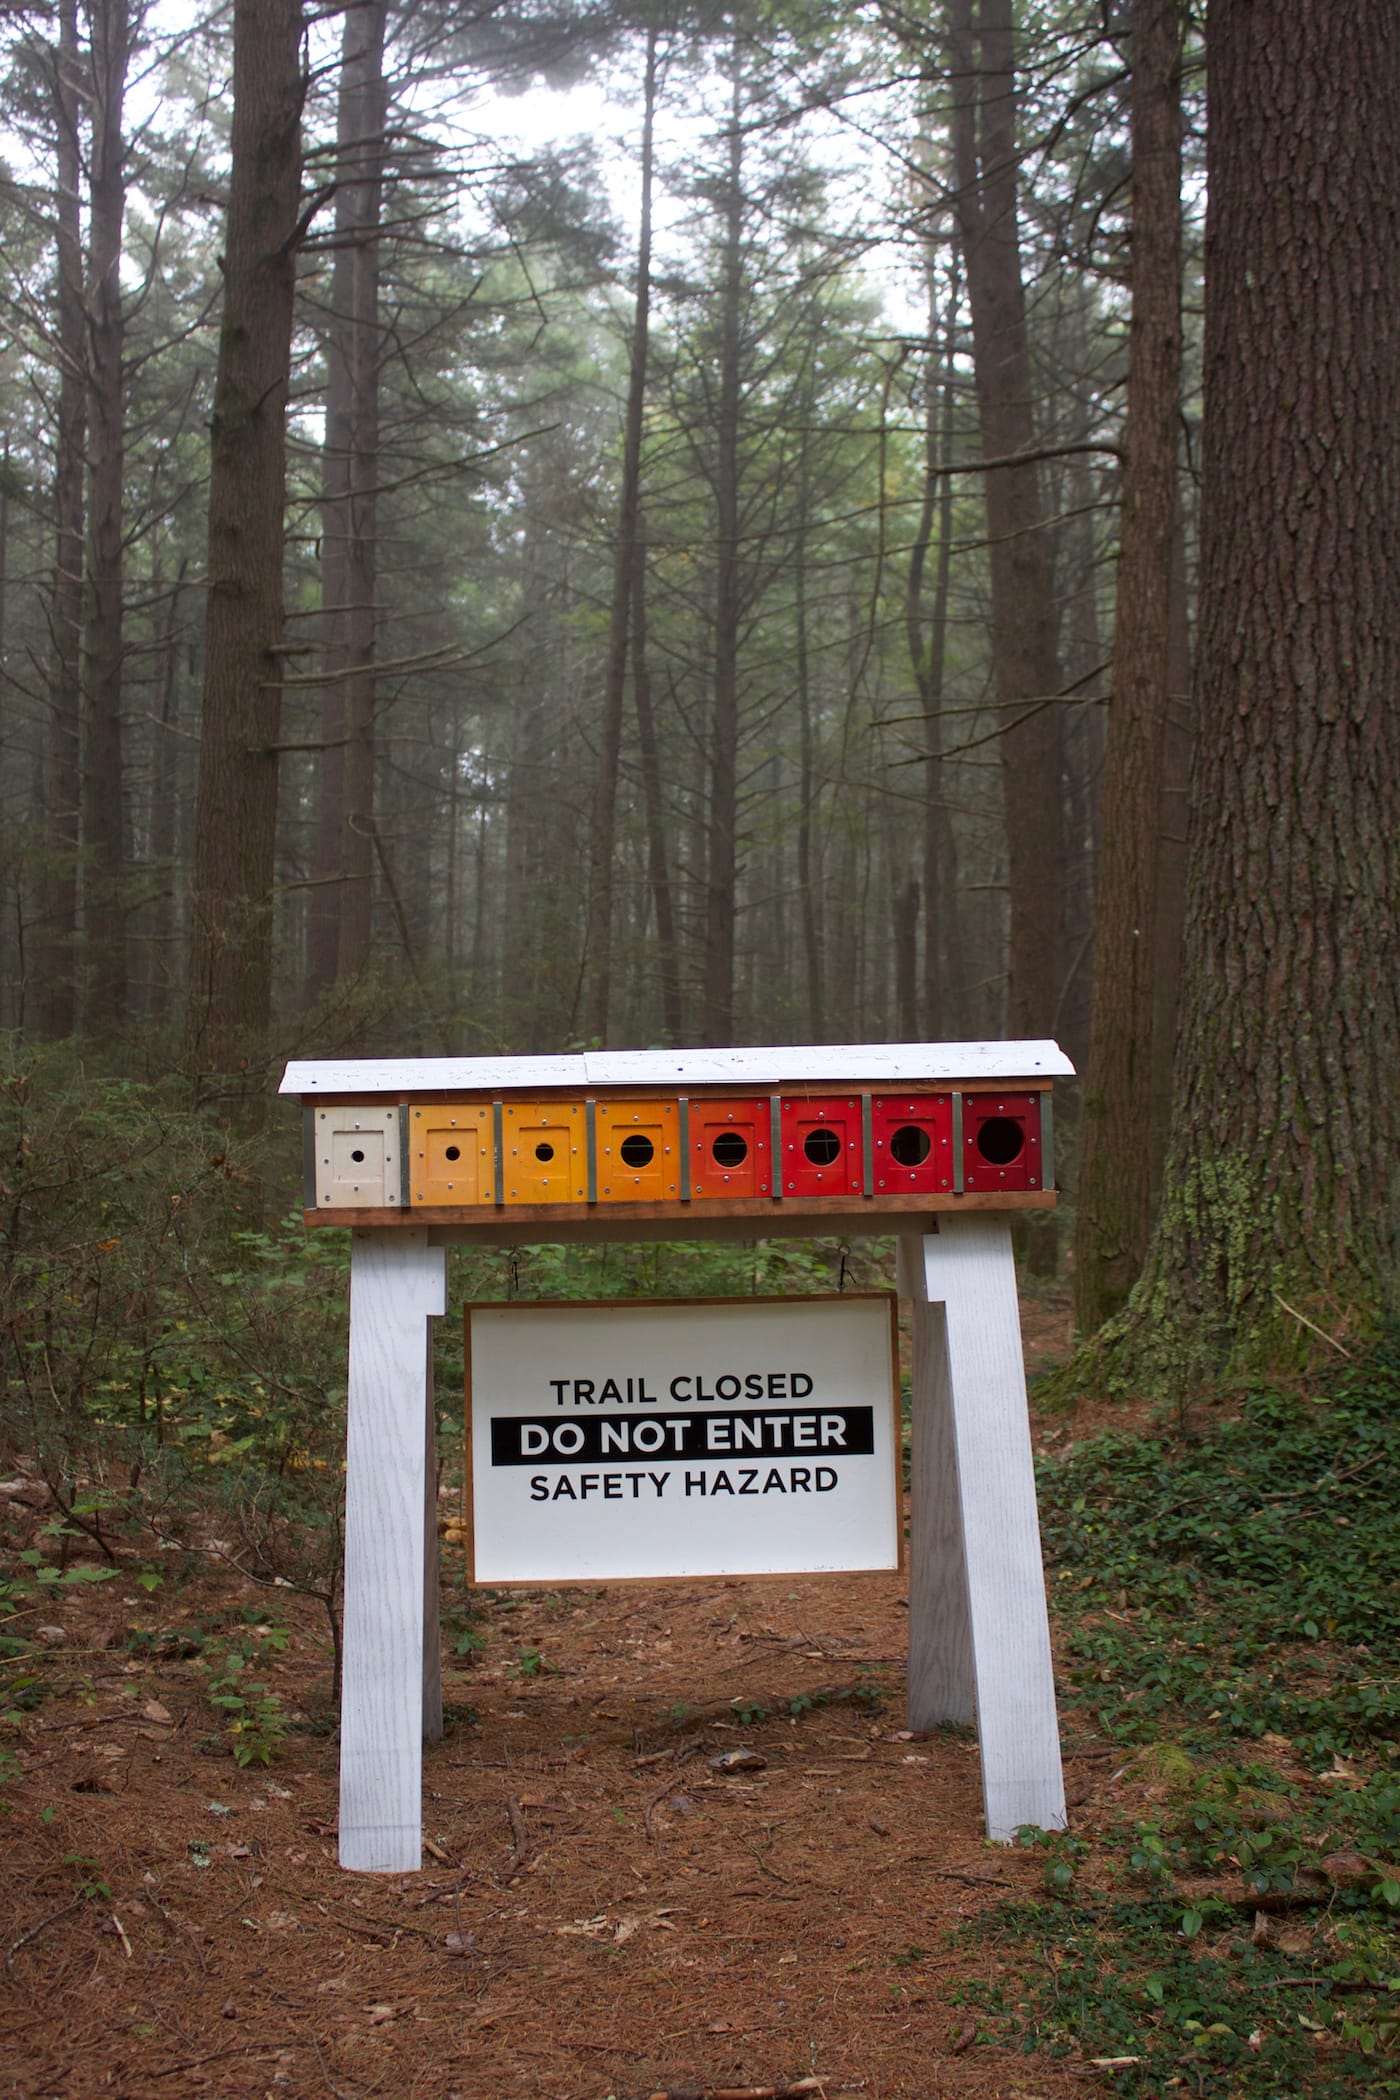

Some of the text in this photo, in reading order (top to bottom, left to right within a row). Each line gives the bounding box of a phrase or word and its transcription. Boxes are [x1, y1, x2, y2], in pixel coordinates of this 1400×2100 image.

[549, 1372, 814, 1406] TRAIL CLOSED
[520, 1415, 847, 1455] DO NOT ENTER
[530, 1466, 838, 1502] SAFETY HAZARD
